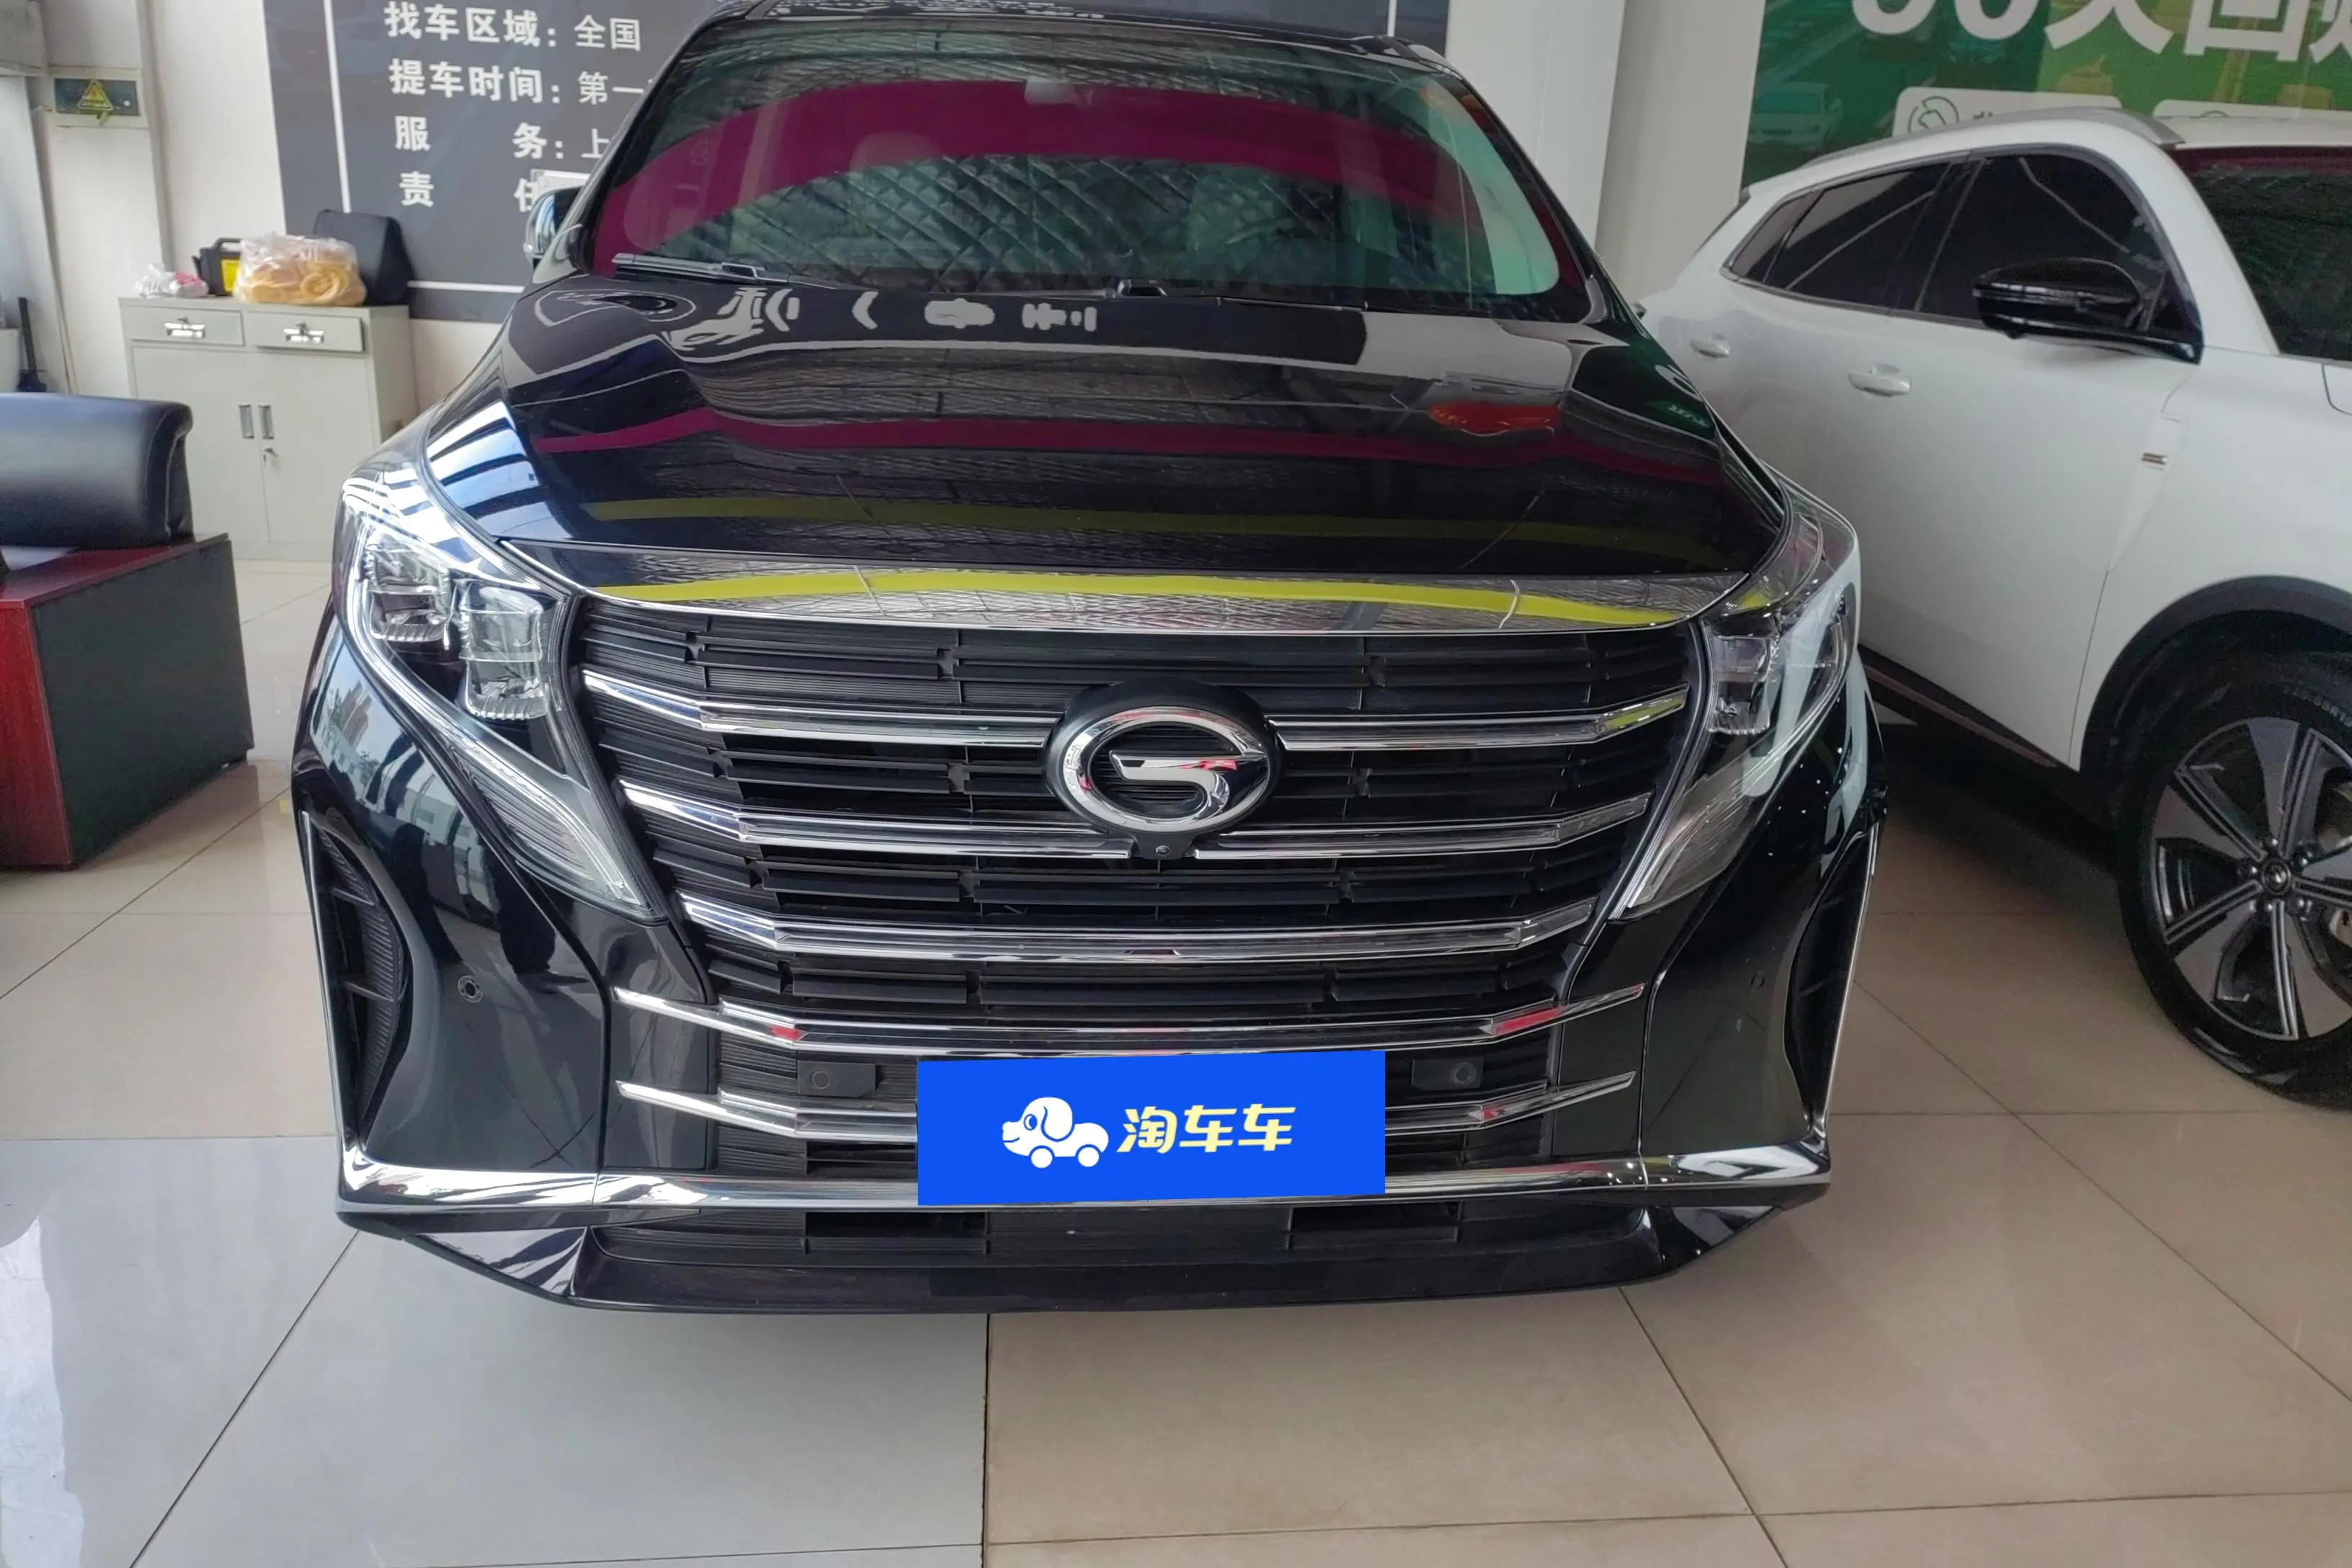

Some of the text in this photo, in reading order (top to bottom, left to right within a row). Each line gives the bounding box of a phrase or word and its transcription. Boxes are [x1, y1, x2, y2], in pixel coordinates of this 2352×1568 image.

[388, 58, 653, 105] 提车时间:第一
